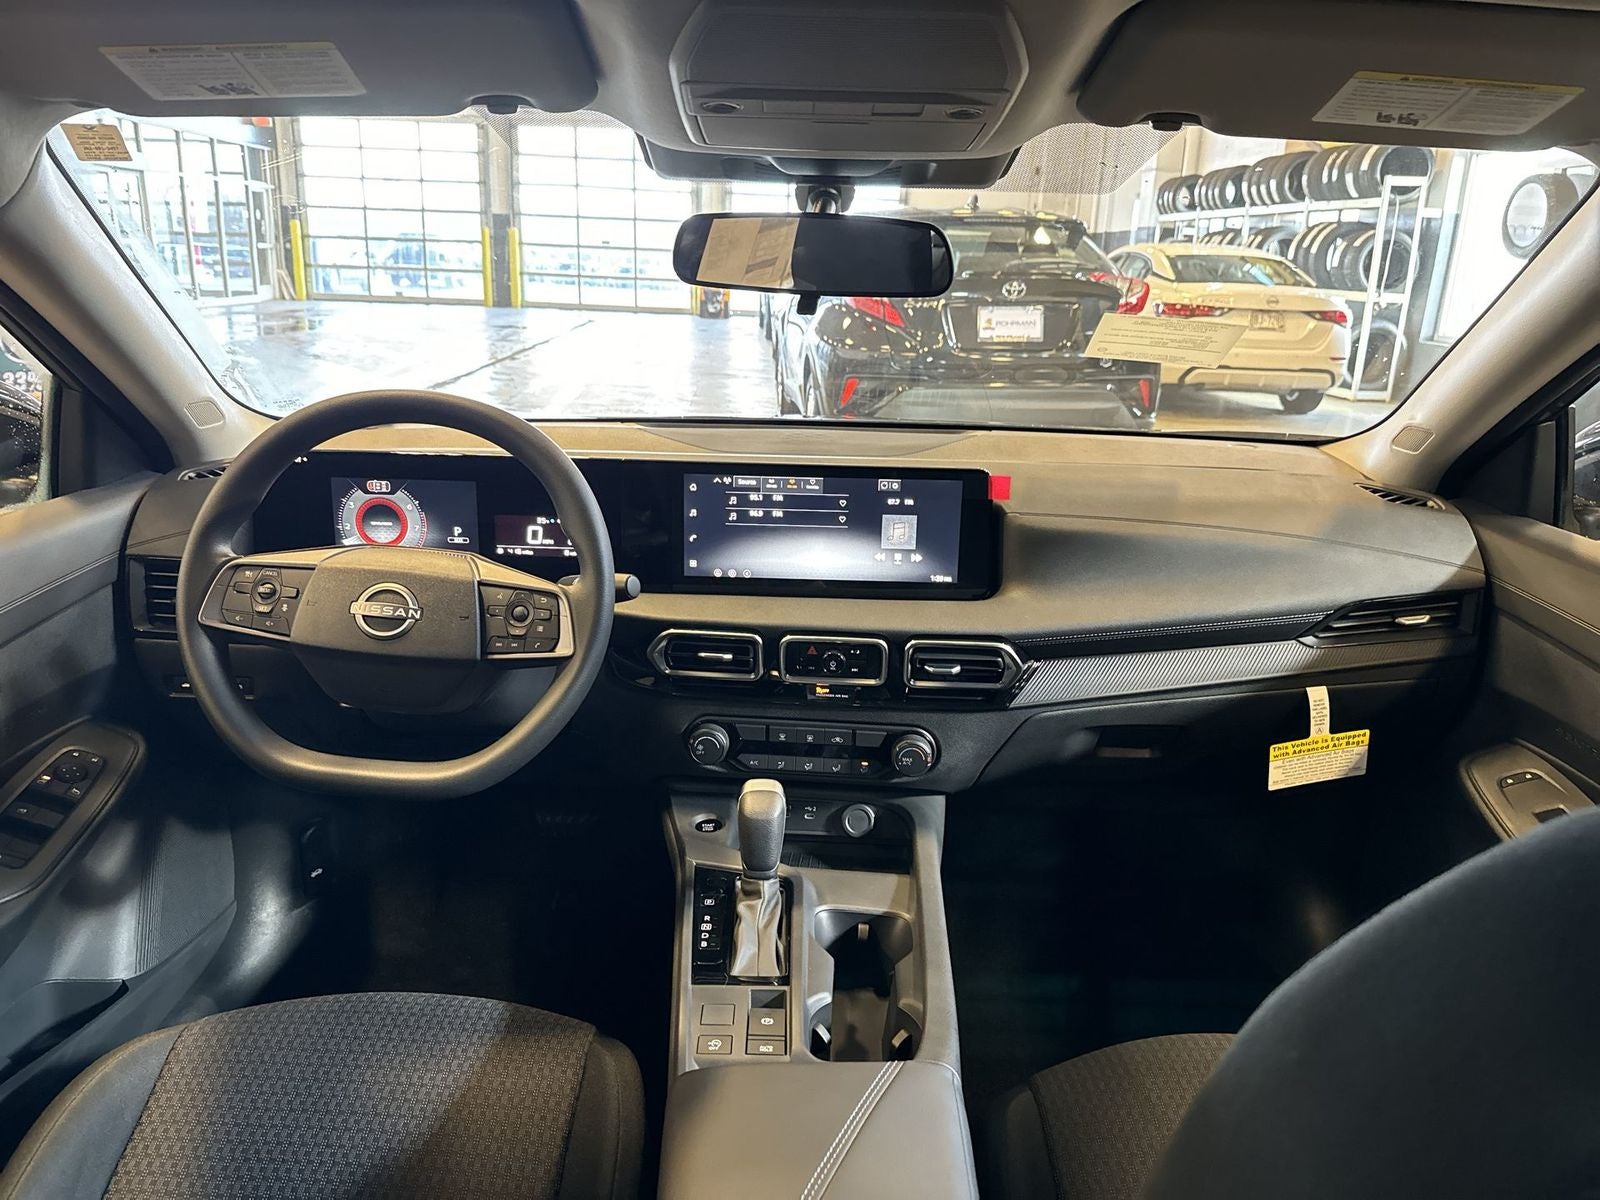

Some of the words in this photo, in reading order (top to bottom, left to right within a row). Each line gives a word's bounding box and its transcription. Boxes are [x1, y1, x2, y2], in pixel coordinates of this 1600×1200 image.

[348, 501, 355, 509] 3
[344, 522, 351, 530] 2
[453, 526, 463, 537] P
[527, 525, 543, 545] 0
[352, 603, 421, 619] NISSAN
[1272, 744, 1290, 753] This
[1291, 739, 1320, 749] Vehicle
[1330, 731, 1367, 743] Equipped
[1273, 751, 1290, 760] with
[1292, 744, 1330, 756] Advanced
[1332, 741, 1344, 749] Air
[1345, 738, 1365, 747] Bags
